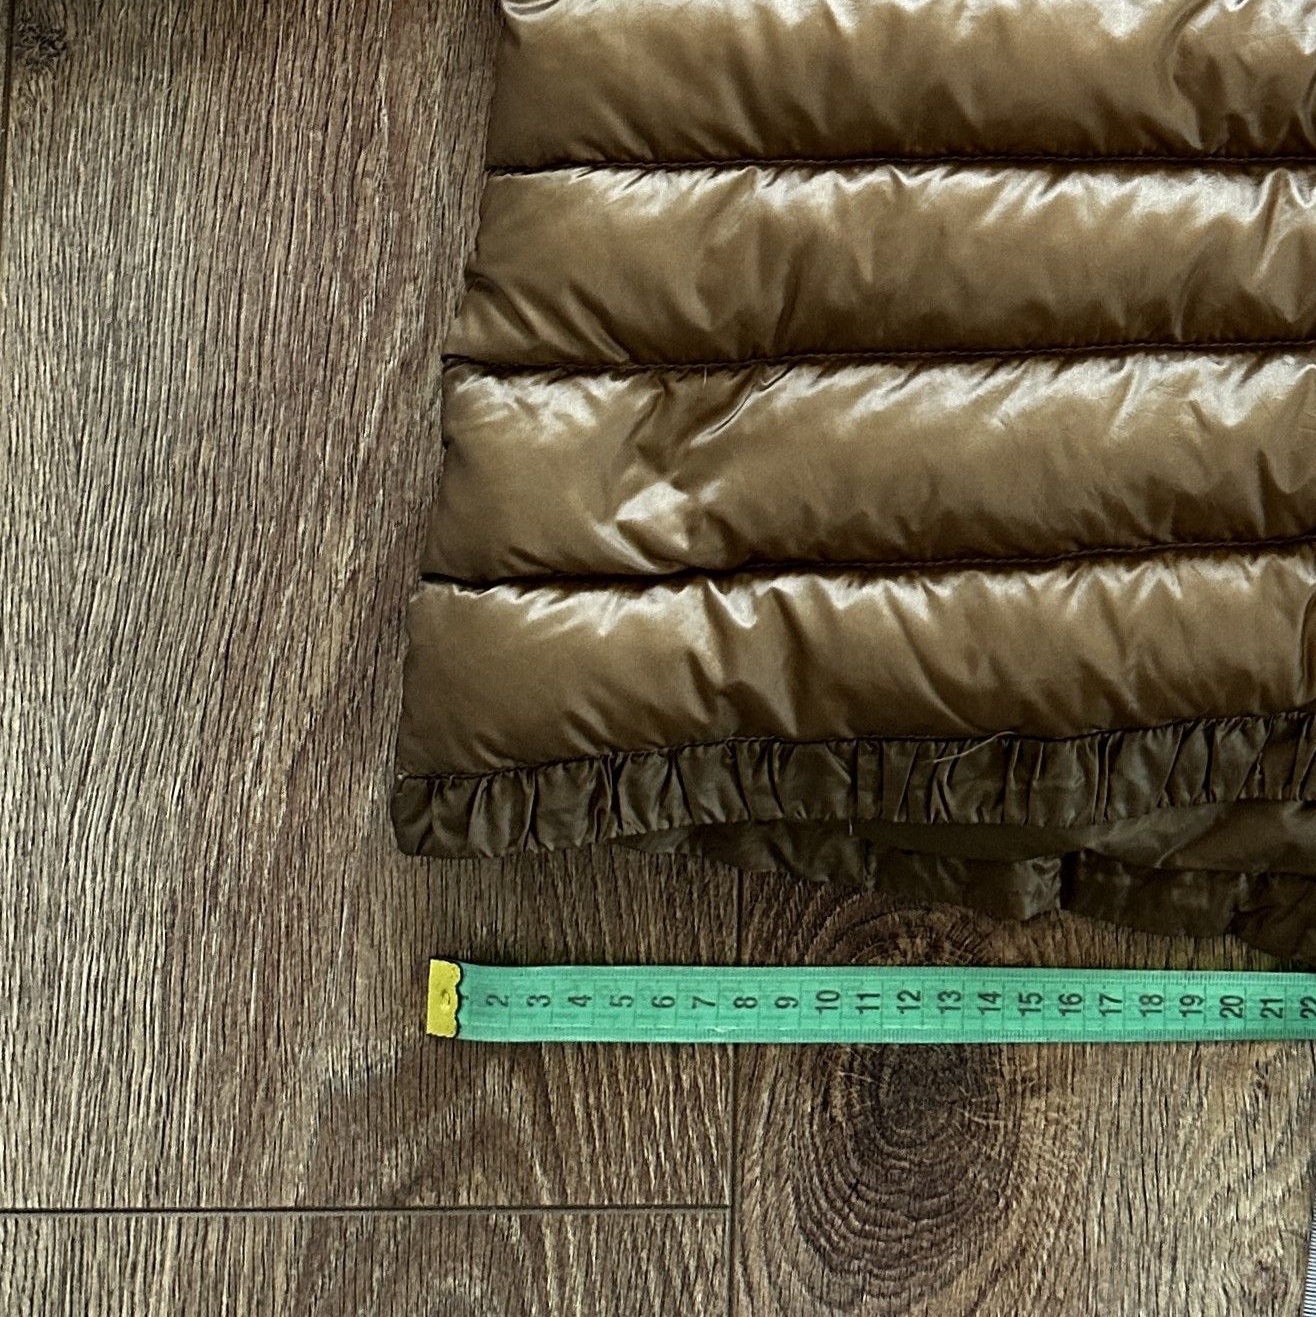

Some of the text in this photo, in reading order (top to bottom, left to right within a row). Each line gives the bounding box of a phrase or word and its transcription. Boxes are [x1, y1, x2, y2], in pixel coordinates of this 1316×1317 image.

[525, 994, 552, 1008] 3
[650, 995, 676, 1009] 6
[732, 995, 759, 1010] 8
[773, 995, 799, 1010] 9
[814, 989, 842, 1015] 10
[895, 989, 922, 1015] 12
[976, 991, 1003, 1016] 14
[1016, 991, 1045, 1017] 15
[1057, 992, 1085, 1017] 16
[1097, 992, 1123, 1018] 17
[1218, 995, 1247, 1021] 20
